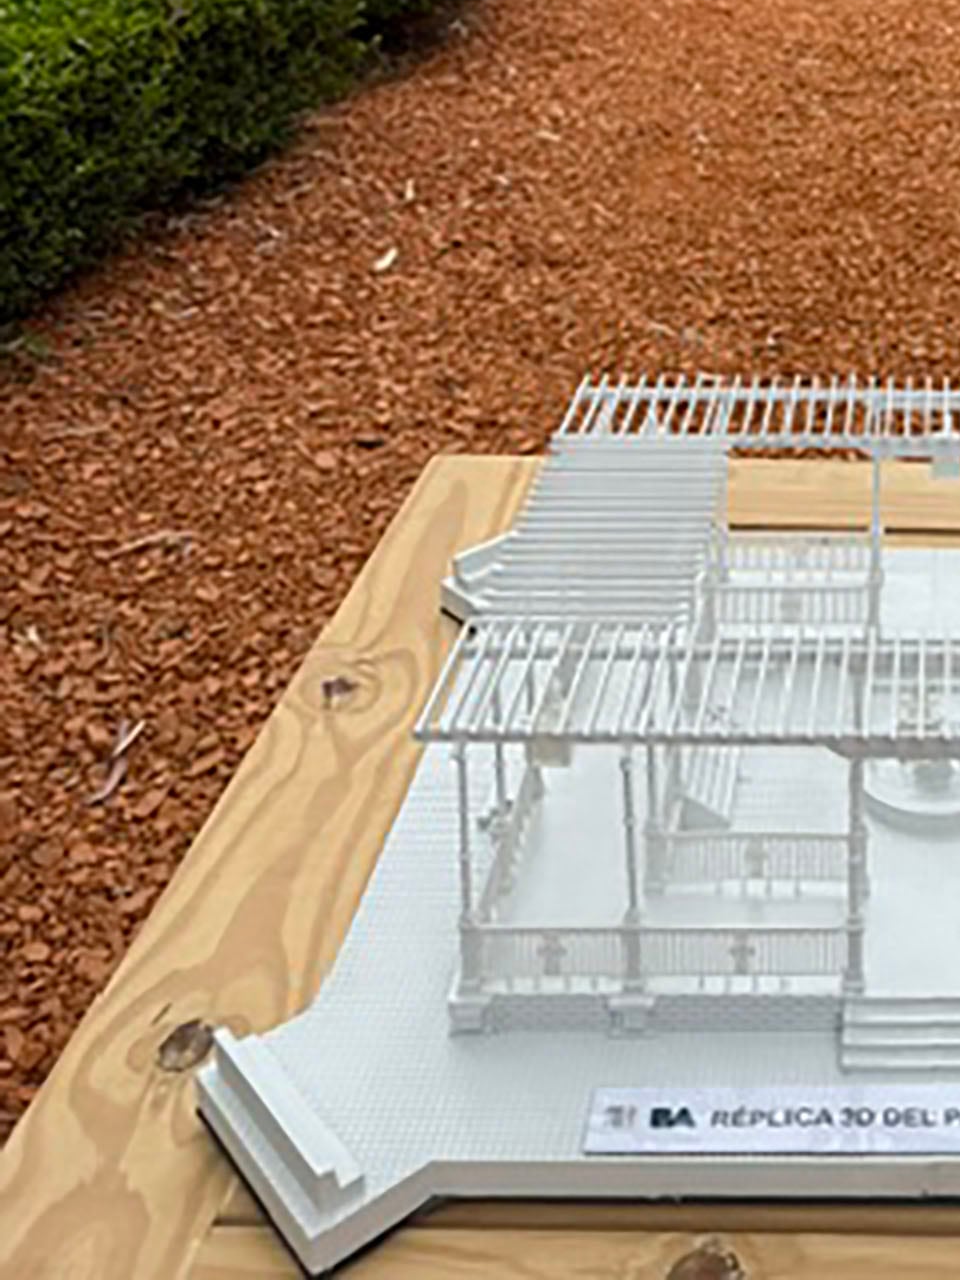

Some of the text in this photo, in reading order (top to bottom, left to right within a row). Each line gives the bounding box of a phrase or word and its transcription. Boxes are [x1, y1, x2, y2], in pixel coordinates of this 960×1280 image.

[650, 1107, 695, 1128] BA
[710, 1105, 834, 1128] RÉPLICA
[882, 1107, 937, 1128] DEL
